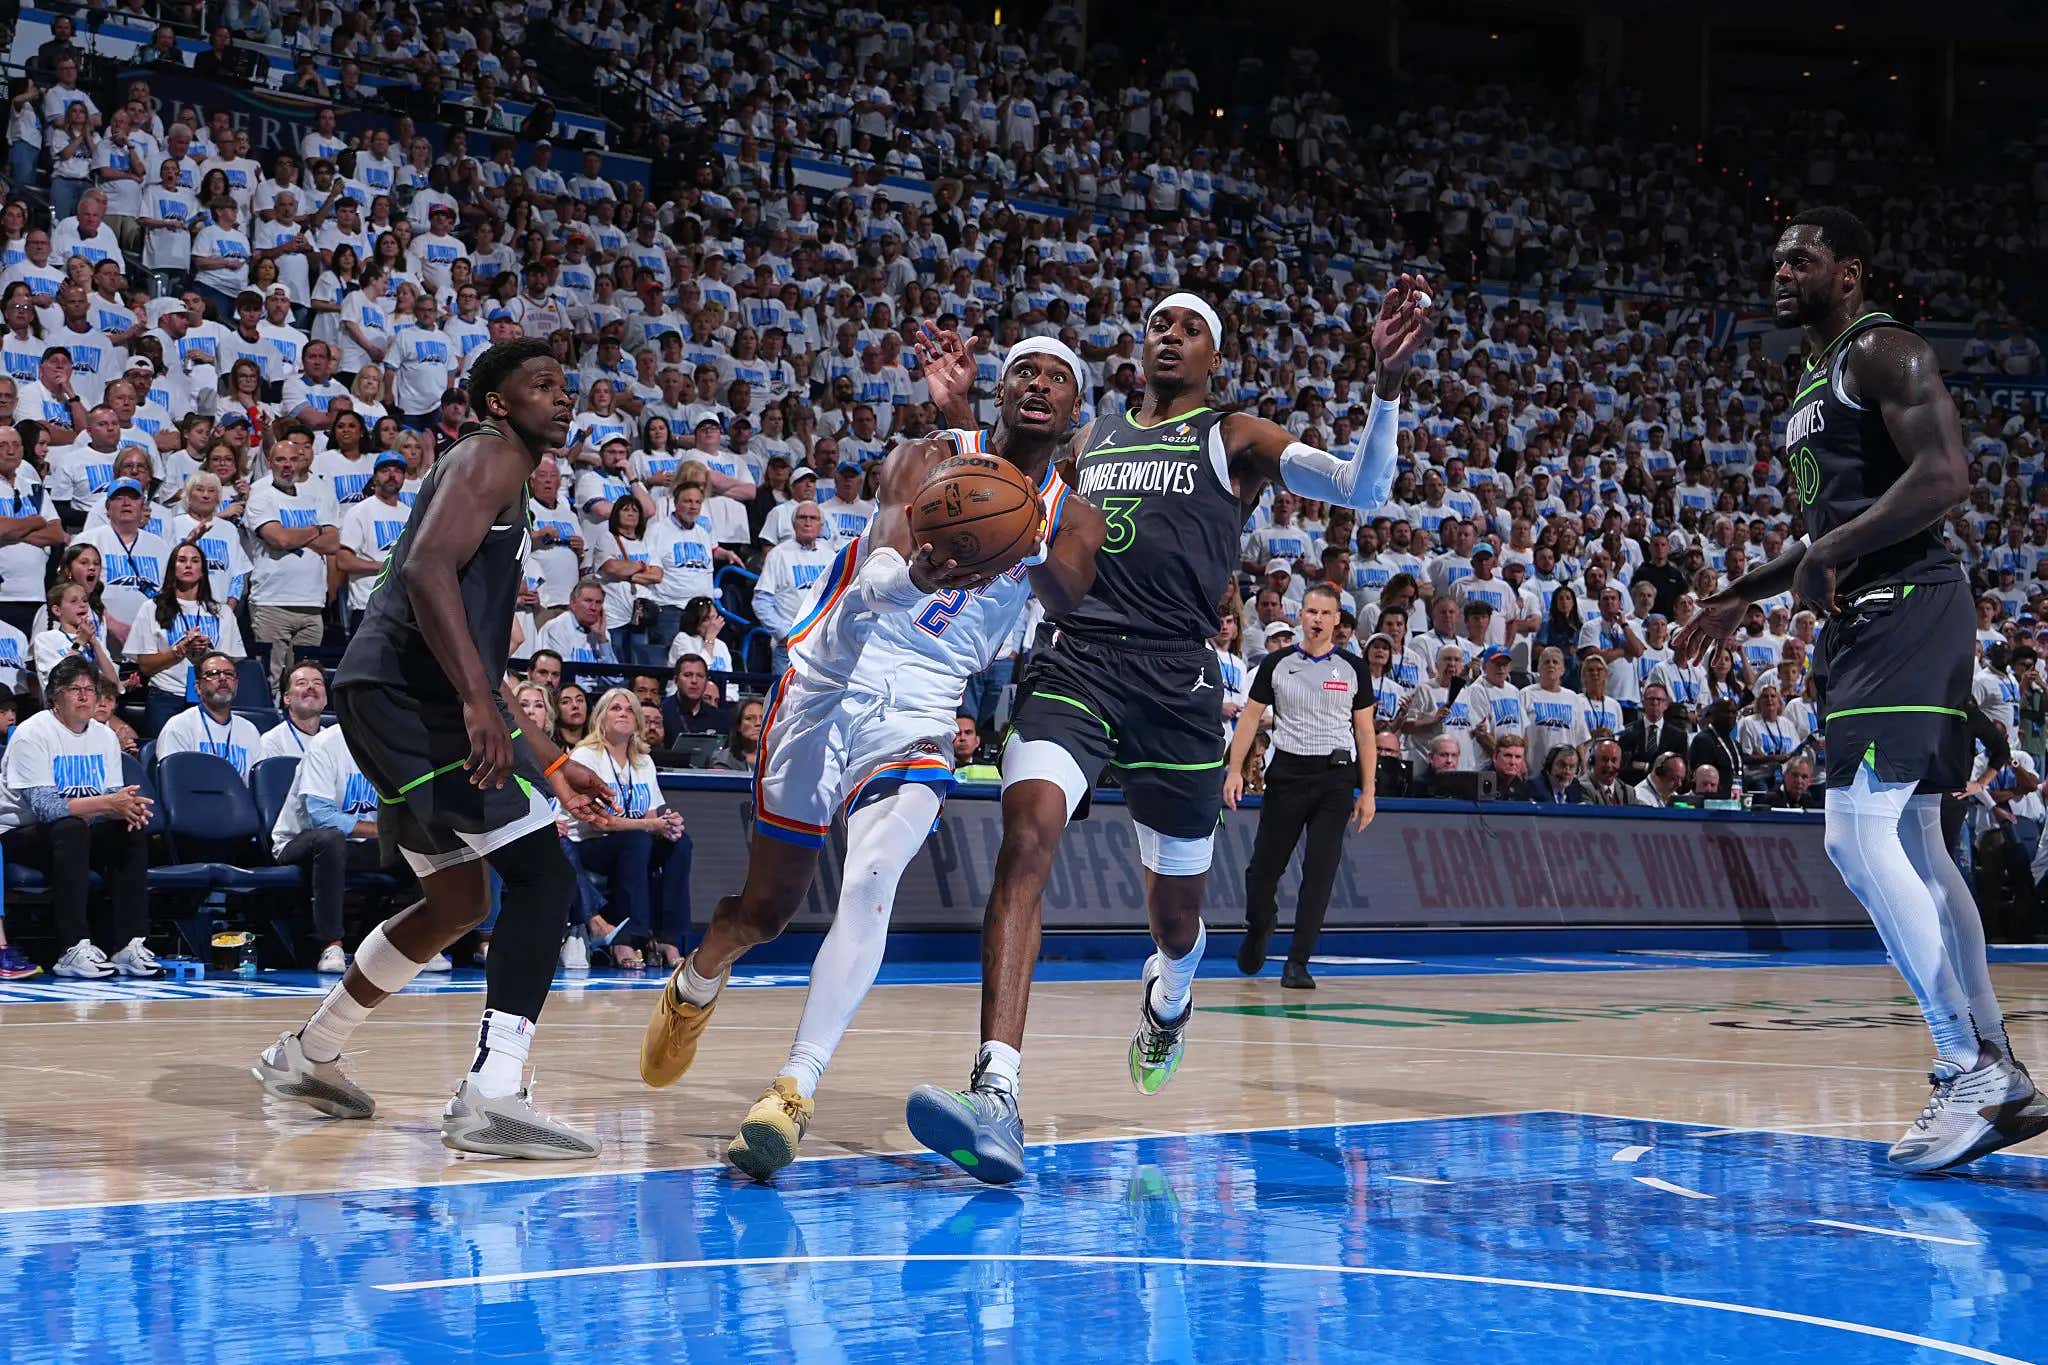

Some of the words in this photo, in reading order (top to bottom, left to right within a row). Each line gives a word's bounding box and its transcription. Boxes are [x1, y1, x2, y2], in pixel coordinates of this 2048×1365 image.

[1161, 435, 1197, 443] sezzle
[1078, 461, 1198, 497] TIMBERWOLVES
[1101, 497, 1142, 553] 3
[914, 586, 969, 637] 2
[1402, 827, 1502, 909] EARN
[1501, 829, 1640, 909] BADGES.
[1632, 832, 1705, 909] WIN
[1702, 835, 1821, 909] PRIZES.
